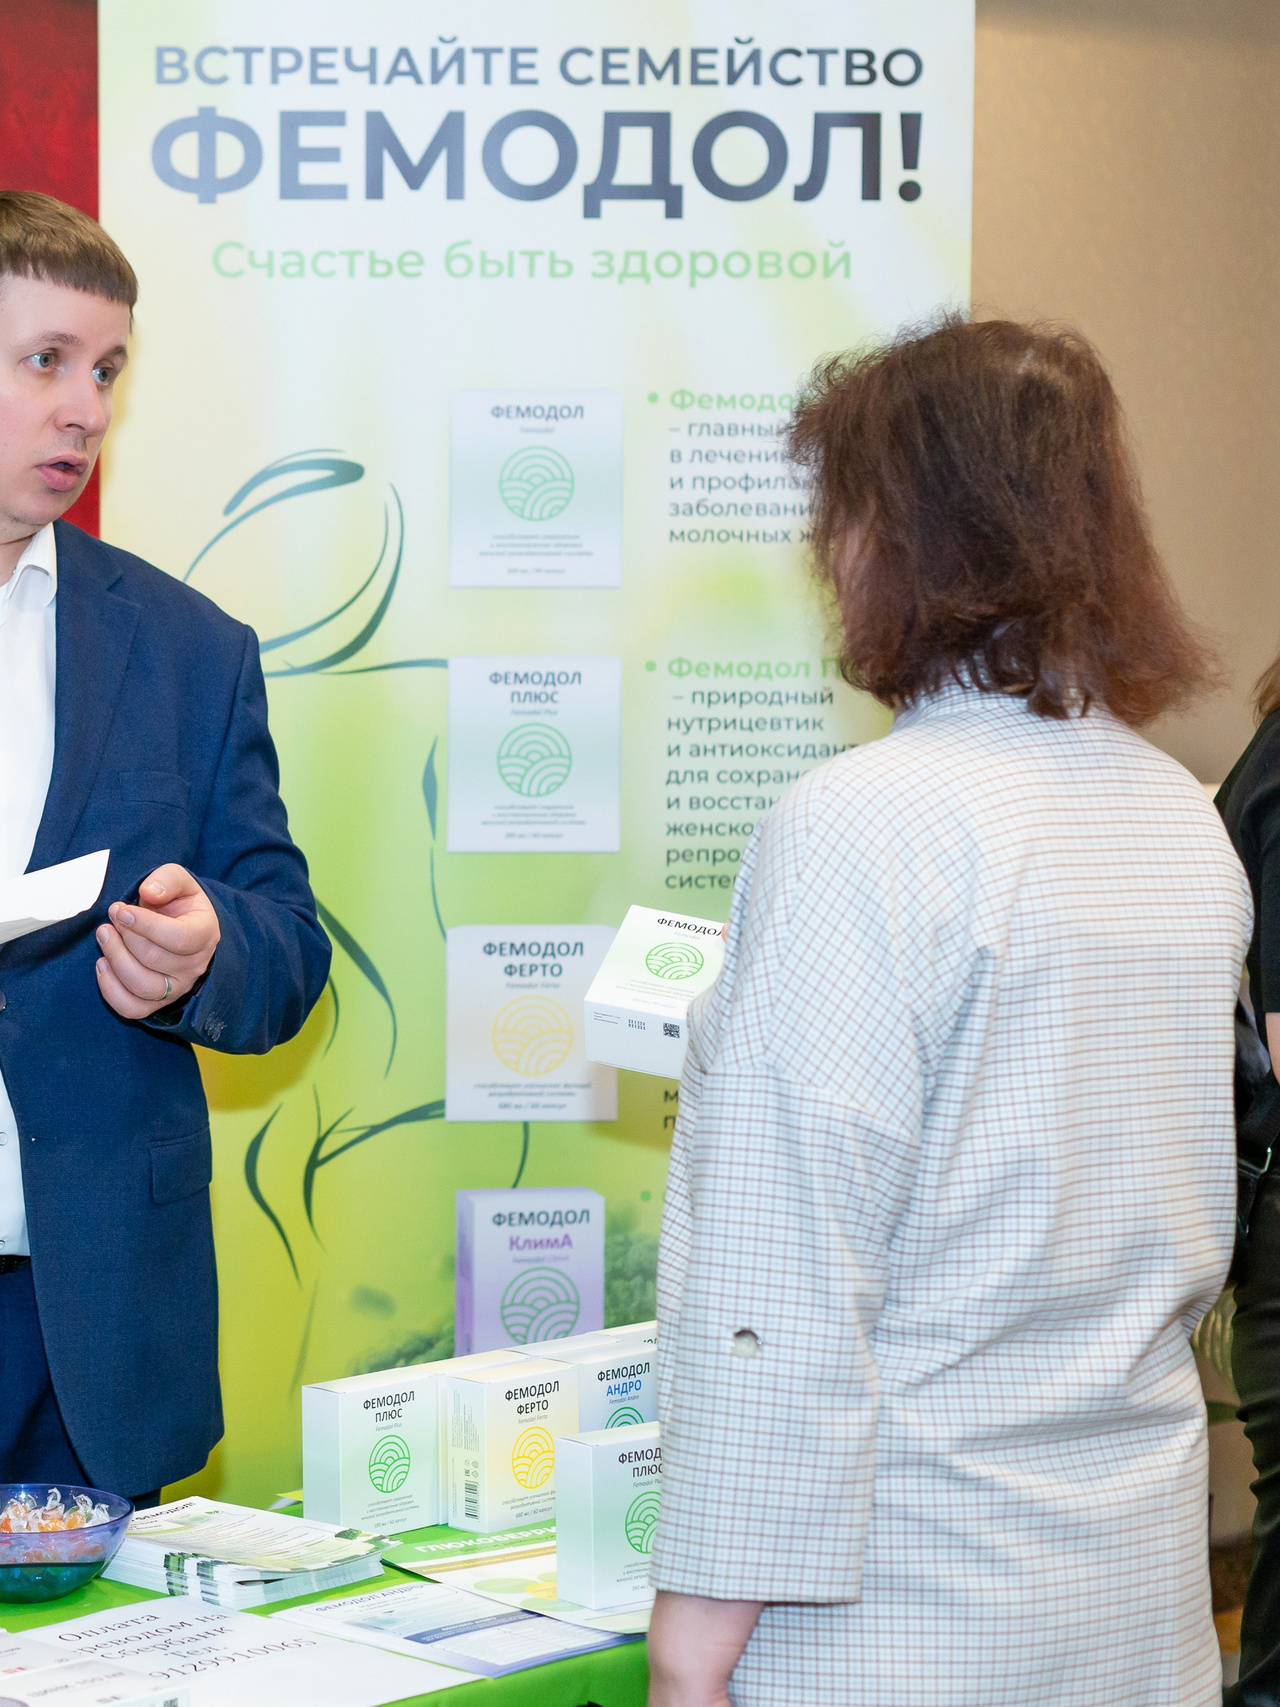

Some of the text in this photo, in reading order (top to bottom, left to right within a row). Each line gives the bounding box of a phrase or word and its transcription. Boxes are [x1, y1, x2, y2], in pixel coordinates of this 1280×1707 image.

[155, 36, 924, 87] ВСТРЕЧАЙТЕ СЕМЕЙСТВО
[151, 105, 924, 219] ФЕМОДОЛ!
[212, 239, 853, 288] Счастье быть здоровой
[491, 405, 584, 421] ФЕМОДОЛ
[670, 449, 682, 463] в
[670, 475, 683, 490] и
[669, 498, 811, 516] заболевани
[669, 529, 792, 544] молочных
[668, 656, 810, 680] Фемодол
[489, 671, 582, 687] ФЕМОДОЛ
[511, 691, 559, 704] ПЛЮС
[691, 687, 834, 708] природный
[667, 717, 824, 735] нутрицевтик
[667, 744, 680, 758] и
[665, 770, 709, 785] для
[666, 796, 680, 810] и
[665, 822, 755, 837] женско
[666, 848, 741, 866] репро
[665, 874, 737, 889] систе
[483, 941, 584, 959] ФЕМОДОЛ
[504, 963, 563, 977] ФЕРТО
[492, 1209, 591, 1228] ФЕМОДОЛ
[509, 1233, 573, 1251] КлимА
[597, 1362, 650, 1382] ФЕМОДОЛ
[504, 1380, 560, 1401] ФЕМОДОЛ
[606, 1379, 642, 1397] АНДРО
[363, 1390, 415, 1410] ФЕМОДОЛ
[516, 1400, 549, 1415] ФЕРТО
[375, 1408, 403, 1422] ПЛЮС
[618, 1447, 663, 1464] ФЕМОД
[58, 1613, 161, 1643] Оплата
[74, 1611, 230, 1655] реводом на
[100, 1625, 234, 1660] Сбербанк
